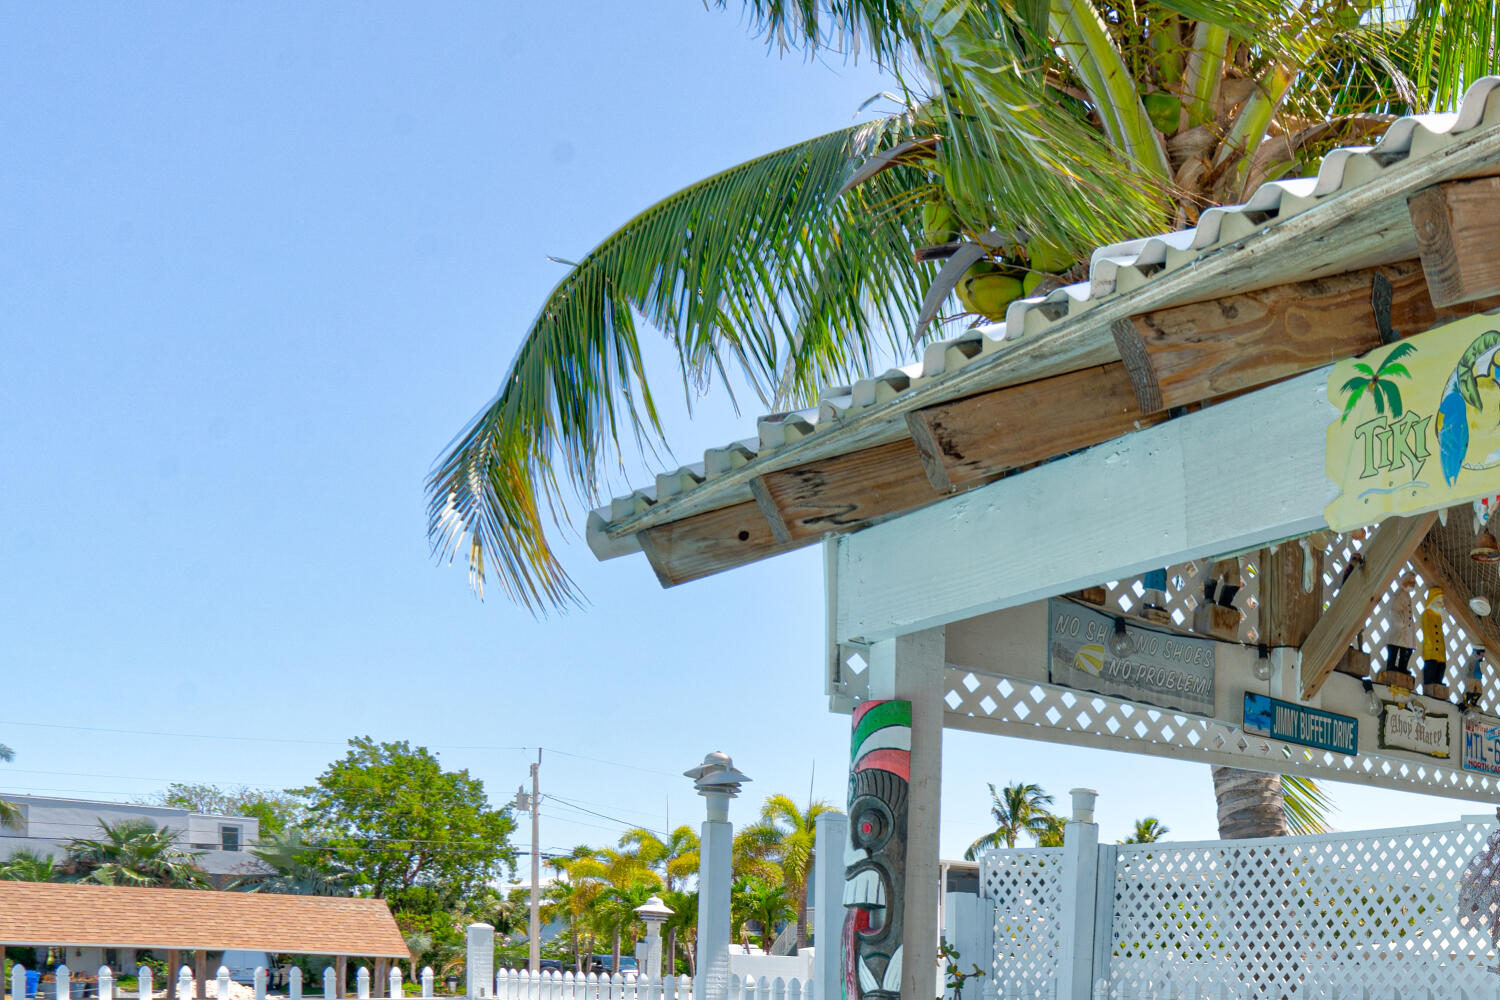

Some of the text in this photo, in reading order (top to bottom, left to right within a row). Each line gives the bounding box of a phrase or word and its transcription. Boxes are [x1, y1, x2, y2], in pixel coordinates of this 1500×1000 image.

[1355, 410, 1432, 480] TIKI
[1055, 614, 1213, 669] NO SHIT NO SHOES
[1108, 658, 1214, 697] NO PROBLEM!
[1273, 705, 1355, 750] JIMMY BUFFETT DRIVE
[1391, 714, 1413, 740] Ahoy
[1468, 759, 1490, 772] NORTH
